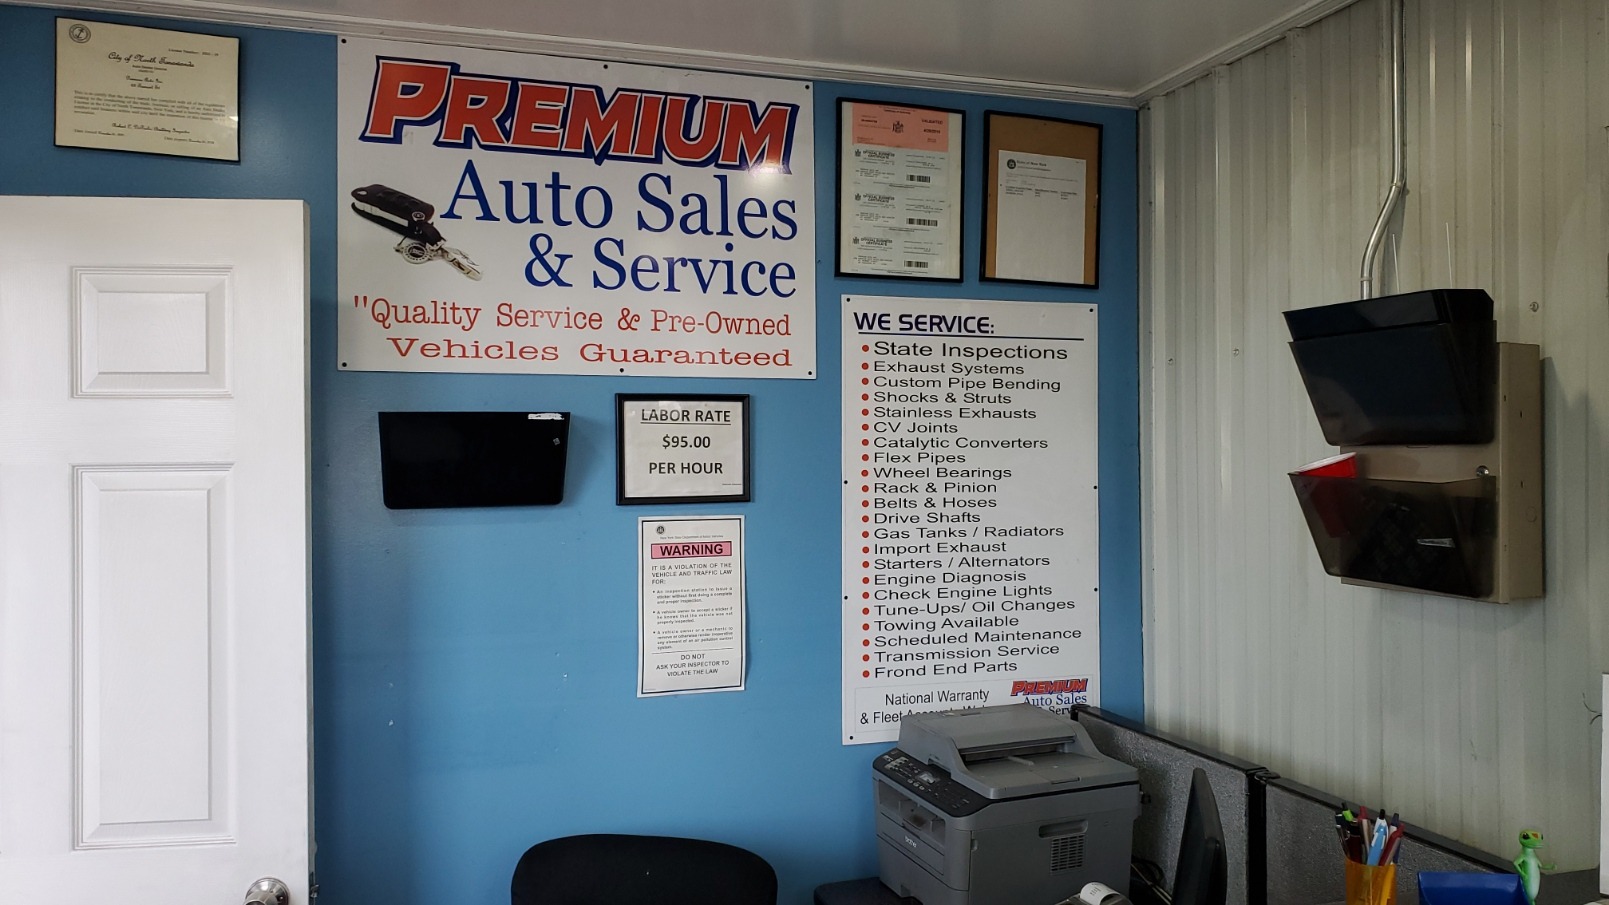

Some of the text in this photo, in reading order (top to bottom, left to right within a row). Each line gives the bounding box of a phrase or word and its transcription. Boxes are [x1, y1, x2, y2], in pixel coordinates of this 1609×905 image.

[359, 55, 800, 174] PREMIUM
[440, 160, 797, 240] Auto Sales
[525, 233, 796, 298] & Service
[497, 303, 602, 330] Service
[618, 308, 640, 331] &
[651, 310, 791, 336] Pre-Owned
[854, 312, 994, 334] WE SERVICE:
[386, 338, 792, 366] Vehicles Guaranteed
[874, 341, 1067, 361] State Inspections
[874, 361, 1024, 376] Exhaust Systems
[874, 376, 1060, 392] Custom Pipe Bending
[874, 392, 1011, 404] Shocks & Struts
[641, 409, 731, 422] LABOR RATE
[874, 407, 1036, 418] Stainless Exhausts
[874, 422, 958, 433] CV Joints
[662, 434, 711, 449] $95.00
[874, 437, 1048, 450] Catalytic Converters
[875, 452, 965, 465] Flex Pipes
[649, 462, 723, 474] PER HOUR
[874, 468, 1011, 480] Wheel Bearings
[875, 482, 996, 493] Rack & Pinion
[875, 497, 996, 508] Belts & Hoses
[875, 512, 980, 523] Drive Shafts
[874, 526, 1064, 539] Gas Tanks / Radiators
[660, 544, 723, 556] WARNING
[875, 542, 1006, 556] Import Exhaust
[875, 556, 1050, 569] Starters / Alternators
[875, 572, 1026, 587] Engine Diagnosis
[874, 585, 1052, 600] Check Engine Lights
[874, 601, 1075, 616] Tune-Ups/ Oil Changes
[874, 616, 1018, 632] Towing Available
[875, 630, 1081, 647] Scheduled Maintenance
[874, 645, 1059, 662] Transmission Service
[875, 662, 1017, 678] Frond End Parts
[1010, 678, 1089, 696] PREMIUM
[886, 689, 989, 705] National Warranty
[1057, 693, 1087, 705] Sales
[860, 713, 868, 724] &
